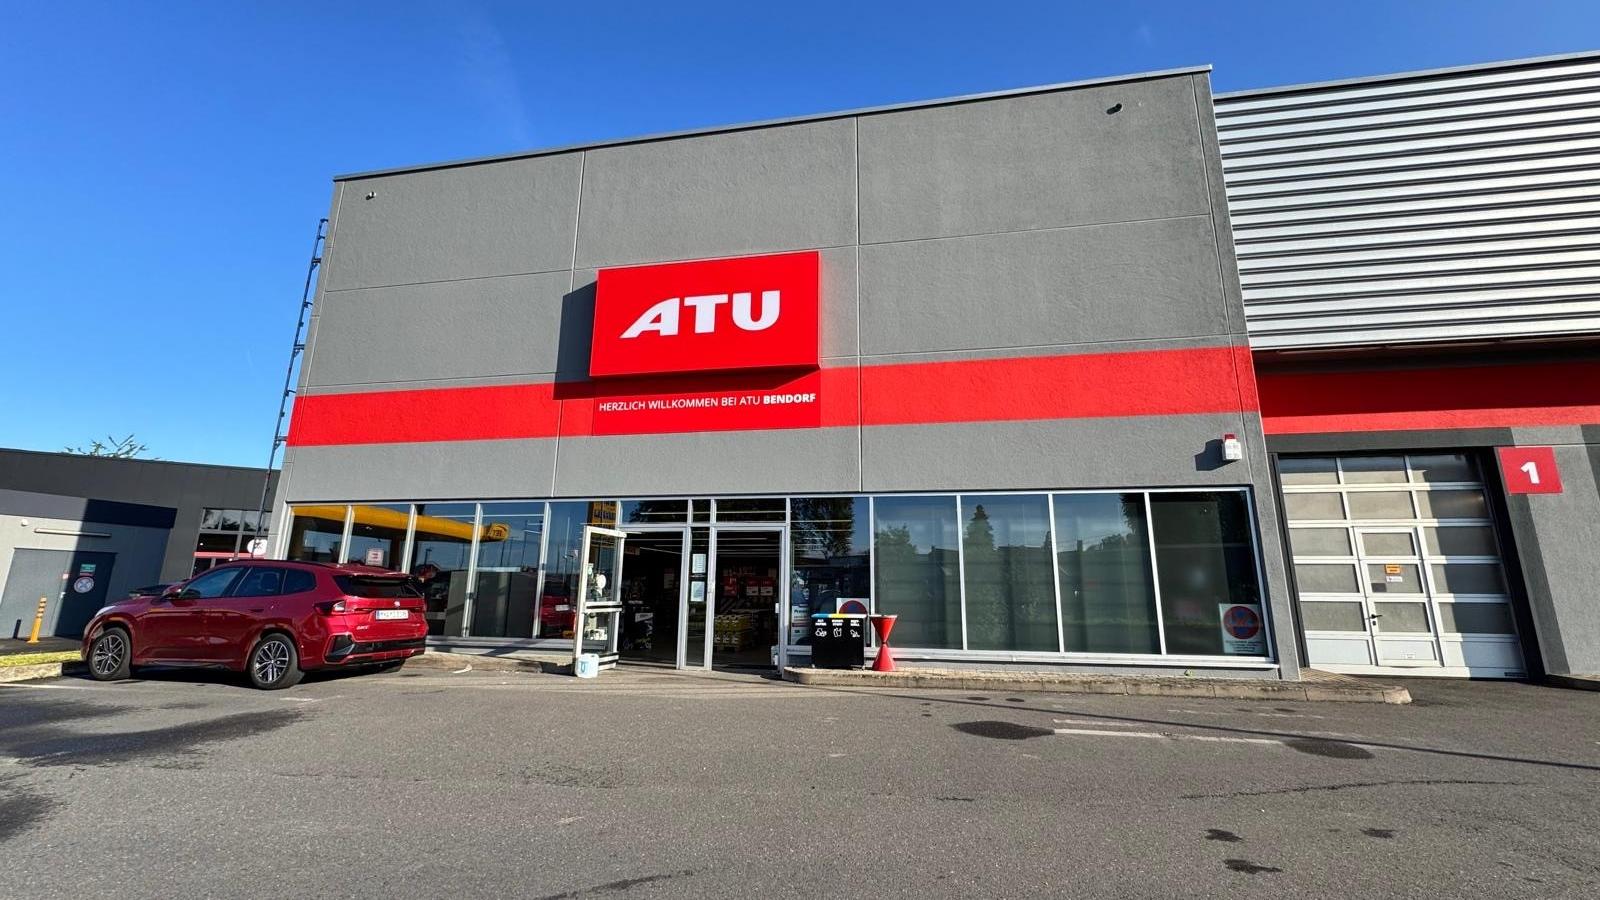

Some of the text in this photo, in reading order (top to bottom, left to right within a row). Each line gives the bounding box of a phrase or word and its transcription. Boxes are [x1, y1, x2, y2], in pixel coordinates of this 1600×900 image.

[621, 290, 781, 339] ATU
[599, 393, 816, 412] HERZLICH WILLKOMMEN BEI ATU BENDORF
[1520, 461, 1541, 485] 1
